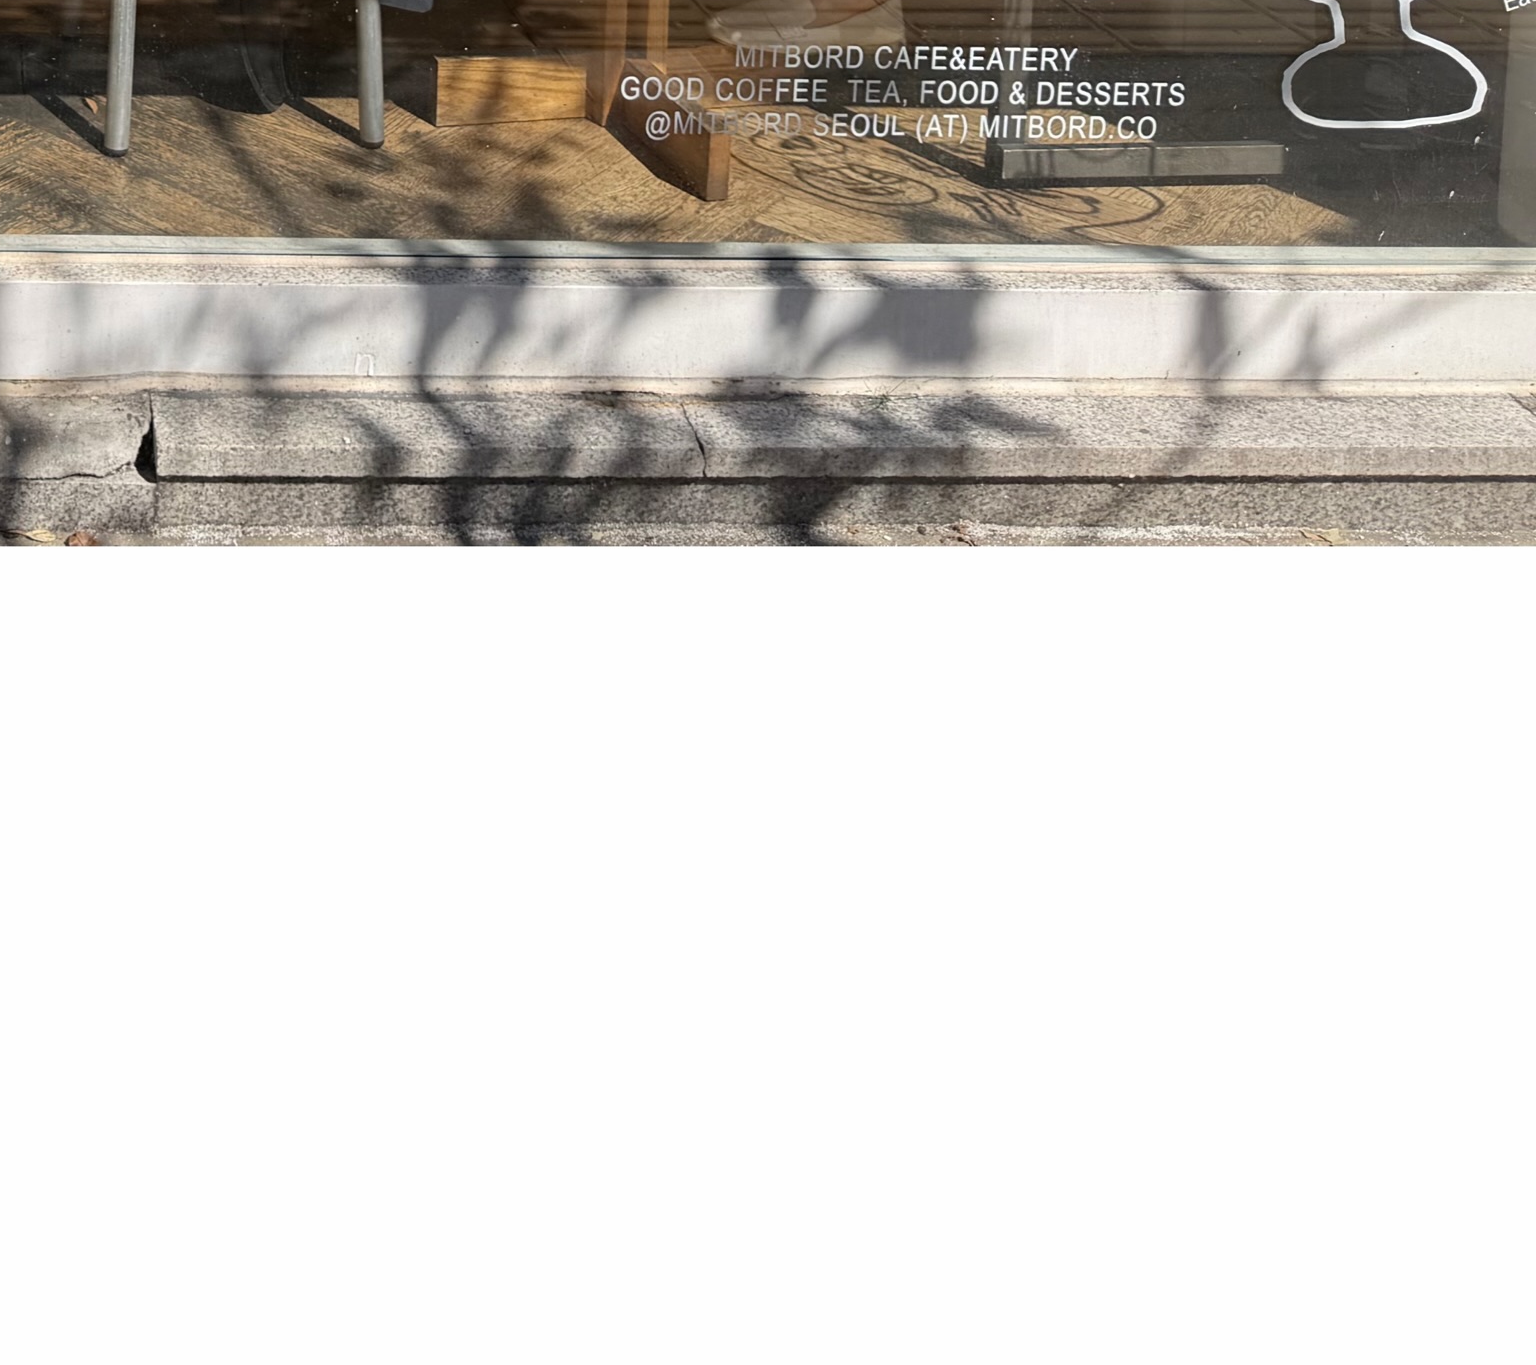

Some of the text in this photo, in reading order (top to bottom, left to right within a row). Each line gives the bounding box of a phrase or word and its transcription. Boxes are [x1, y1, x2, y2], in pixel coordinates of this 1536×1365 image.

[734, 44, 1079, 73] MITBORD CAFE&EATERY
[619, 75, 1186, 107] GOOD COFFEE TEA, FOOD & DESSERTS
[644, 111, 1158, 144] @MITBORD SEOUL (AT) MITBORD.CO
